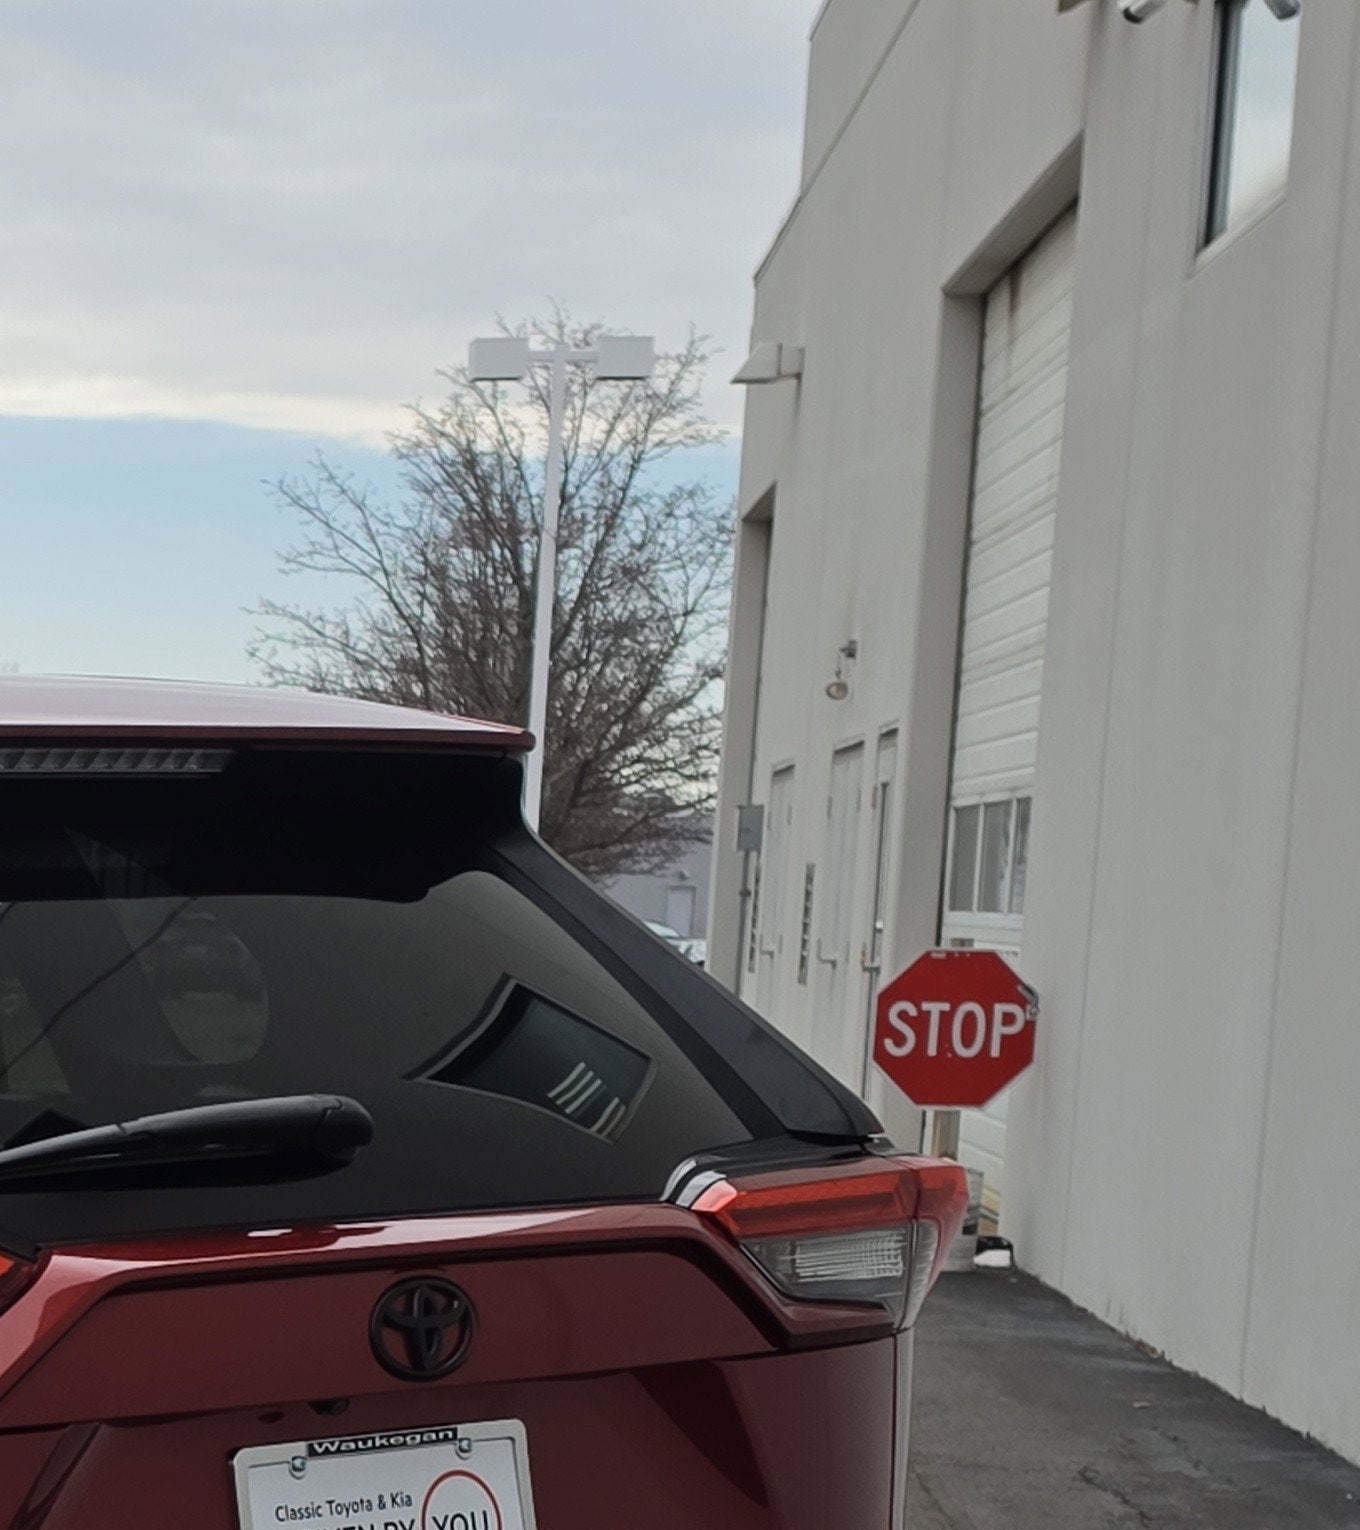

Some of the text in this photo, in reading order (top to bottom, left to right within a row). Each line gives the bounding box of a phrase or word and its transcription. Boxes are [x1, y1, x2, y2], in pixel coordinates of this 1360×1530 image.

[883, 1001, 1026, 1058] STOP
[312, 1429, 454, 1454] Waukegan
[275, 1491, 413, 1522] Classic Toyota & Kia
